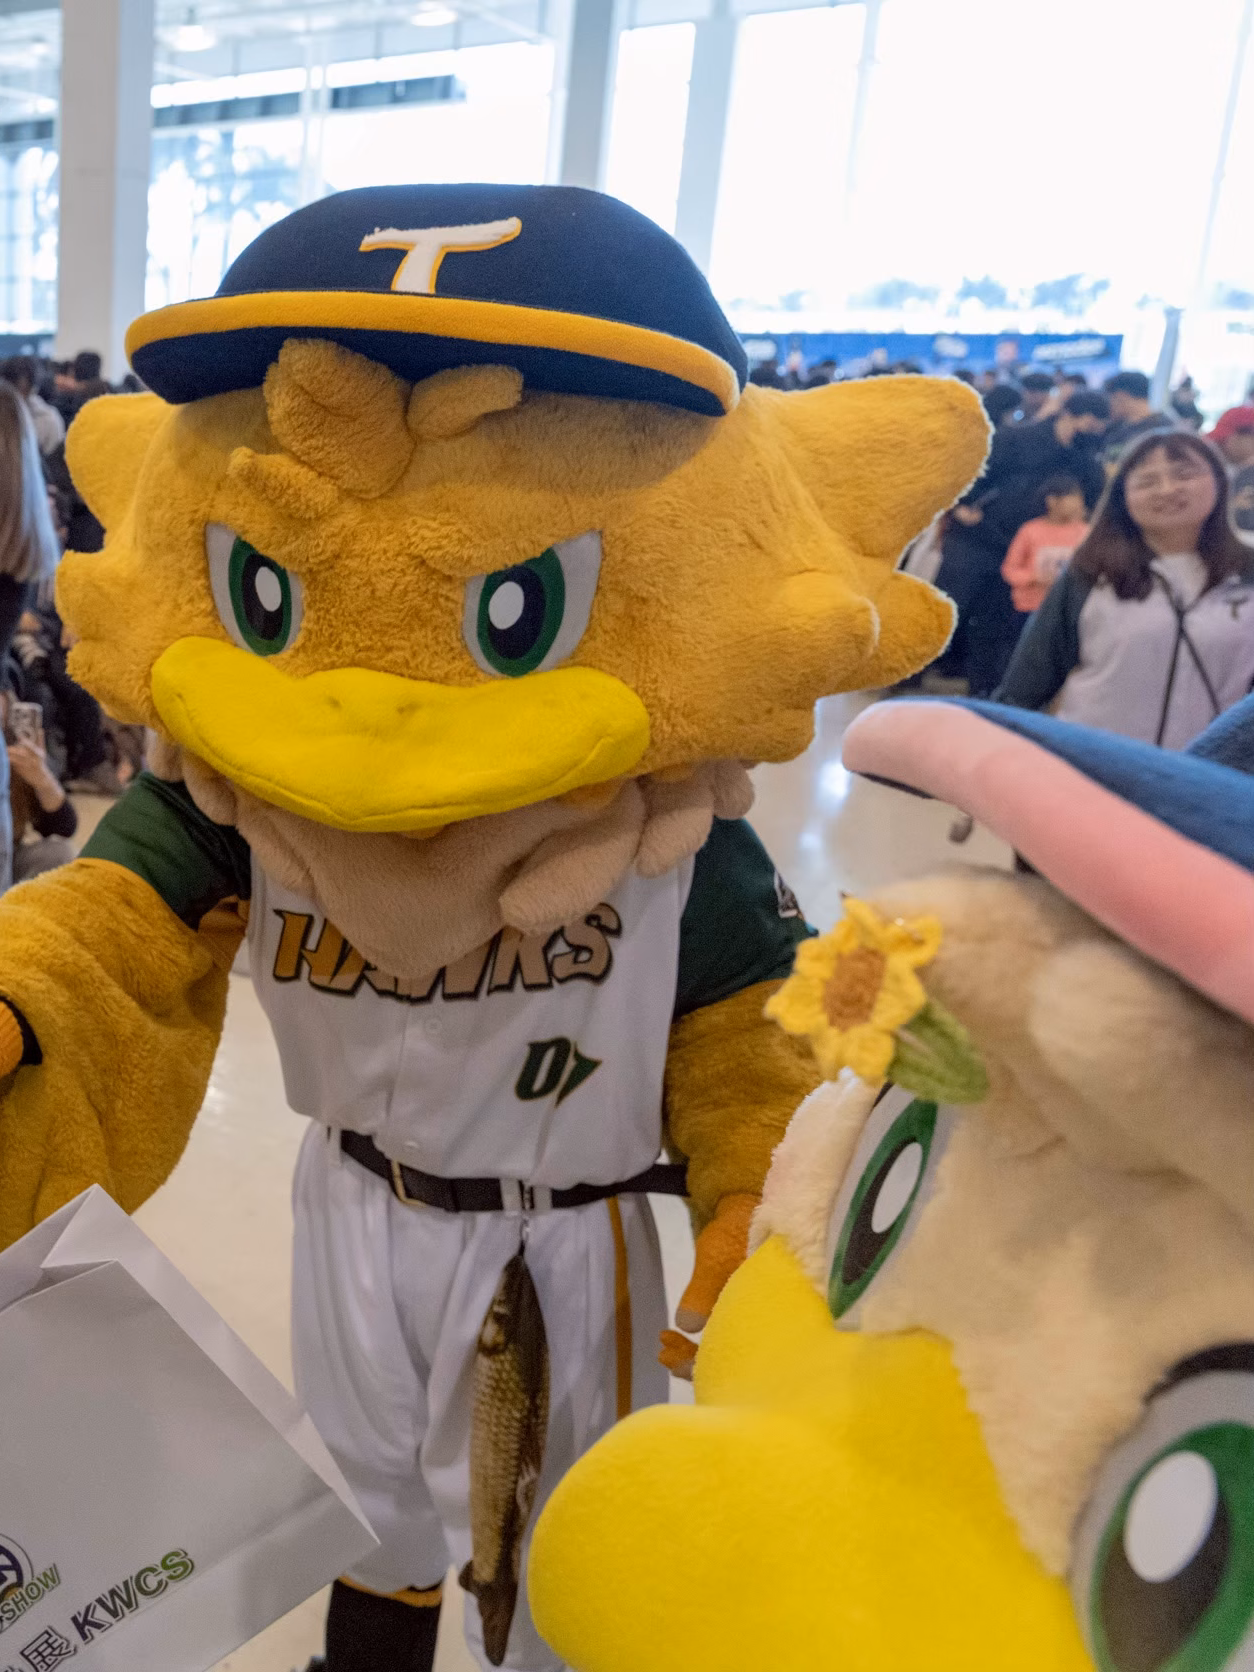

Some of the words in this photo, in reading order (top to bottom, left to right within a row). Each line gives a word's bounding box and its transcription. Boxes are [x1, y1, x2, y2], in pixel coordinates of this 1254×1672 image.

[359, 217, 522, 294] T
[0, 1565, 60, 1621] SHOW
[4, 1627, 73, 1672] 展
[70, 1550, 192, 1643] KWCS
